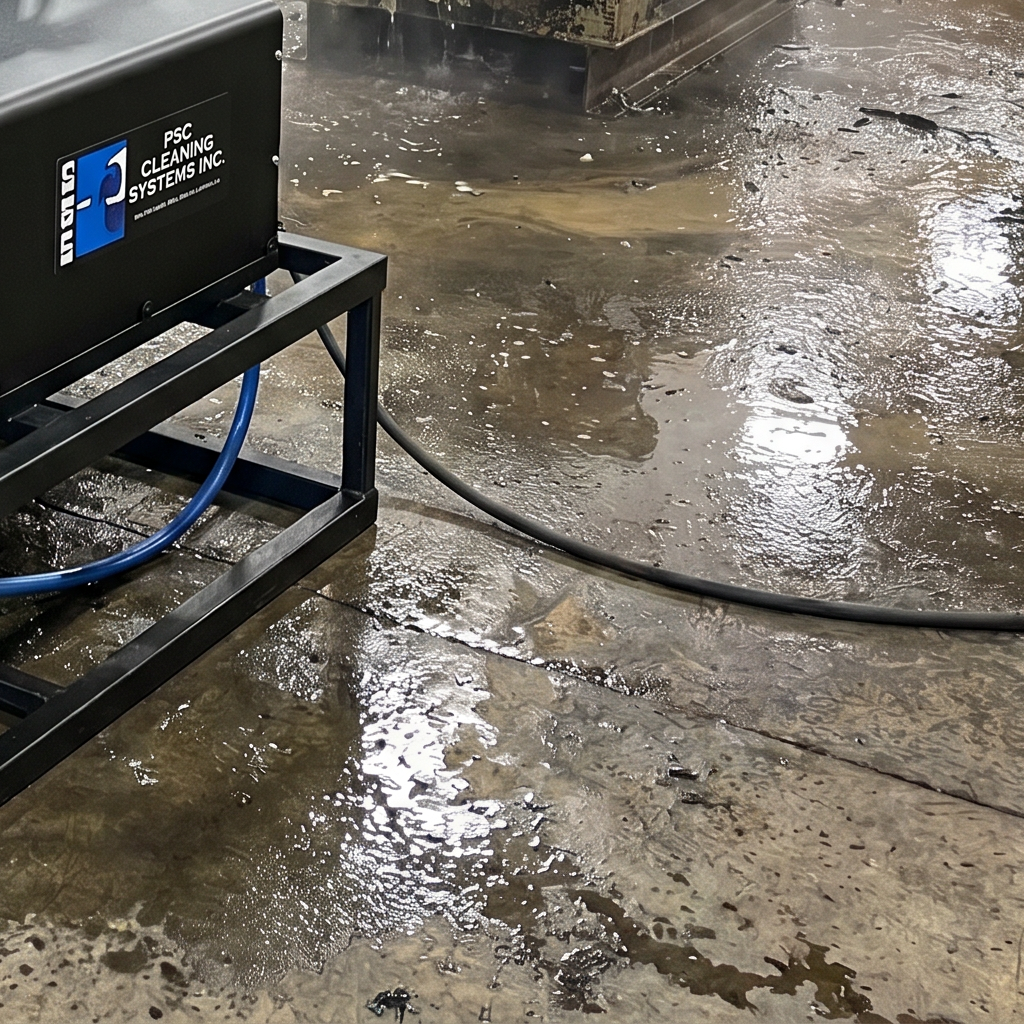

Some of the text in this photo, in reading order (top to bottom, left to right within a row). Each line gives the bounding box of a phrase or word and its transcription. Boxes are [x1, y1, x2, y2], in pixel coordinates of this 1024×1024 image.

[141, 134, 214, 177] CLEANING
[164, 123, 193, 149] PSC
[128, 161, 196, 204] SYSTEMS
[198, 150, 225, 174] INC.
